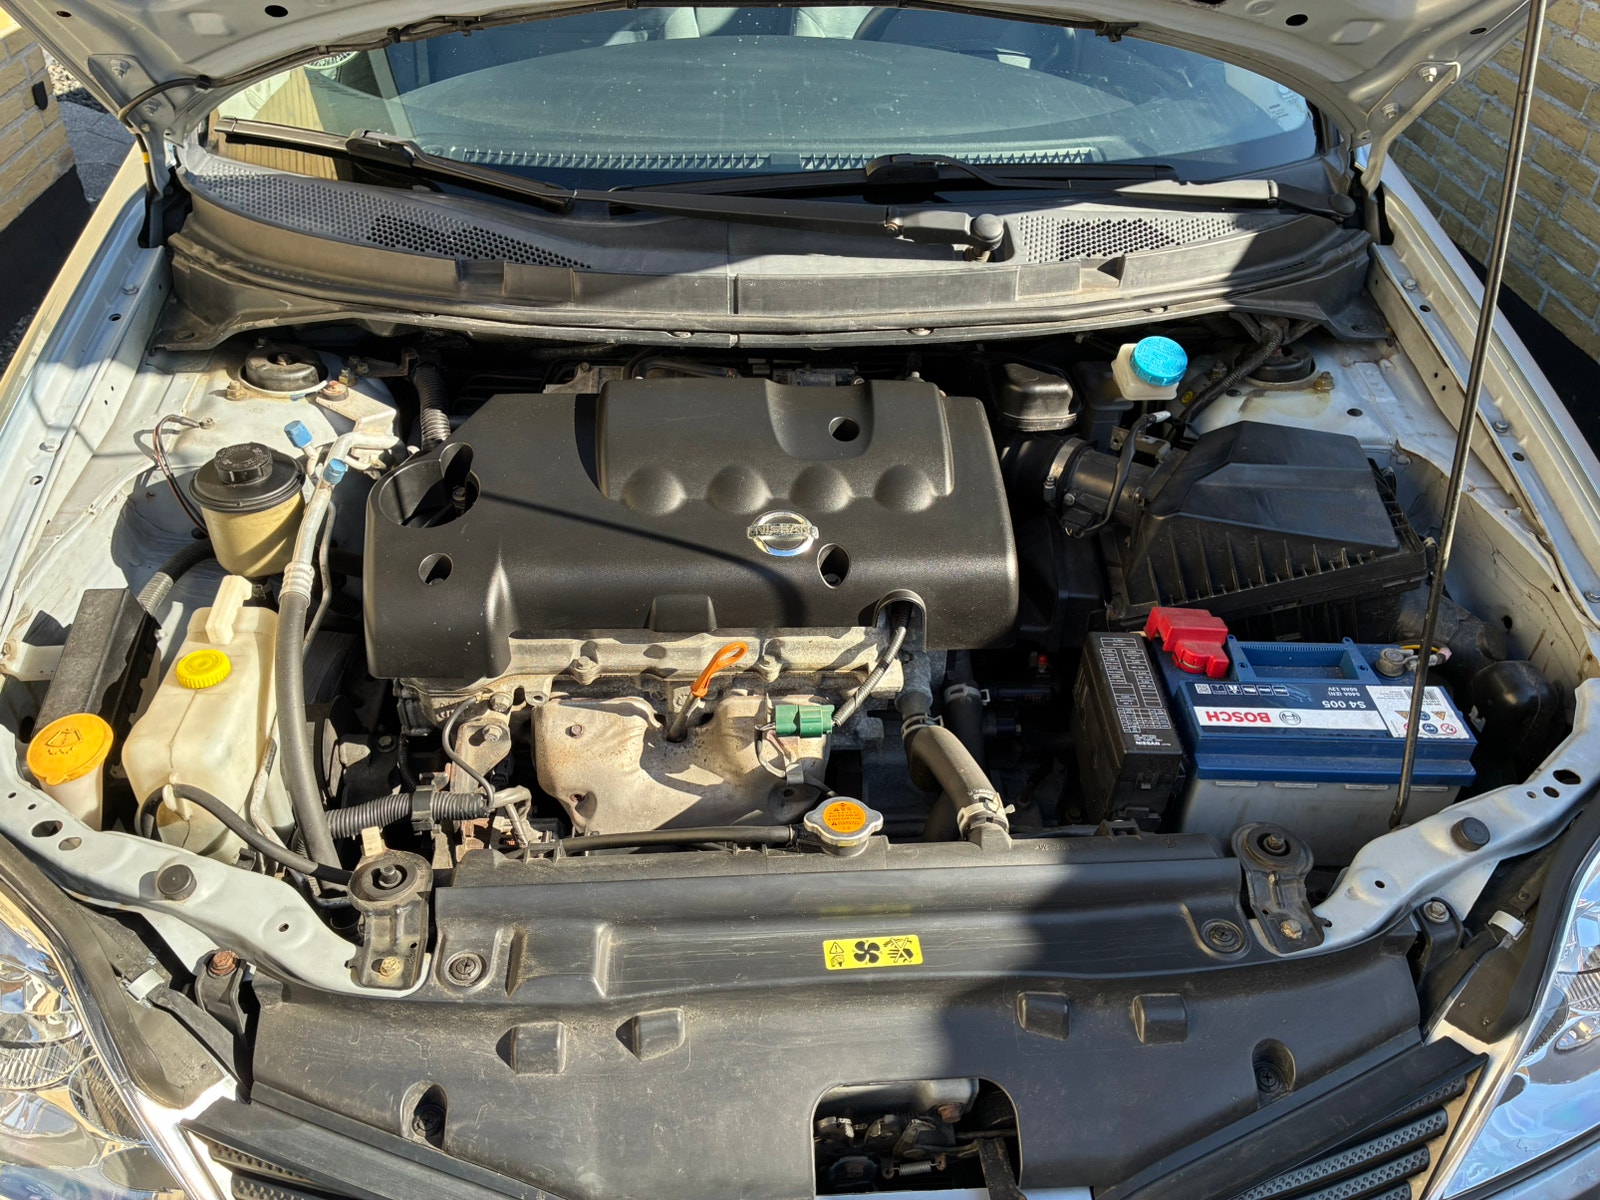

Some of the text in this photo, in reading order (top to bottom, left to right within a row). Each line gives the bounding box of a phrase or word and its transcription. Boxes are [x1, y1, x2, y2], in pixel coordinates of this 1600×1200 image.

[757, 524, 809, 534] NISSAN
[1321, 700, 1367, 709] S4 005
[1206, 711, 1271, 723] BOSCH
